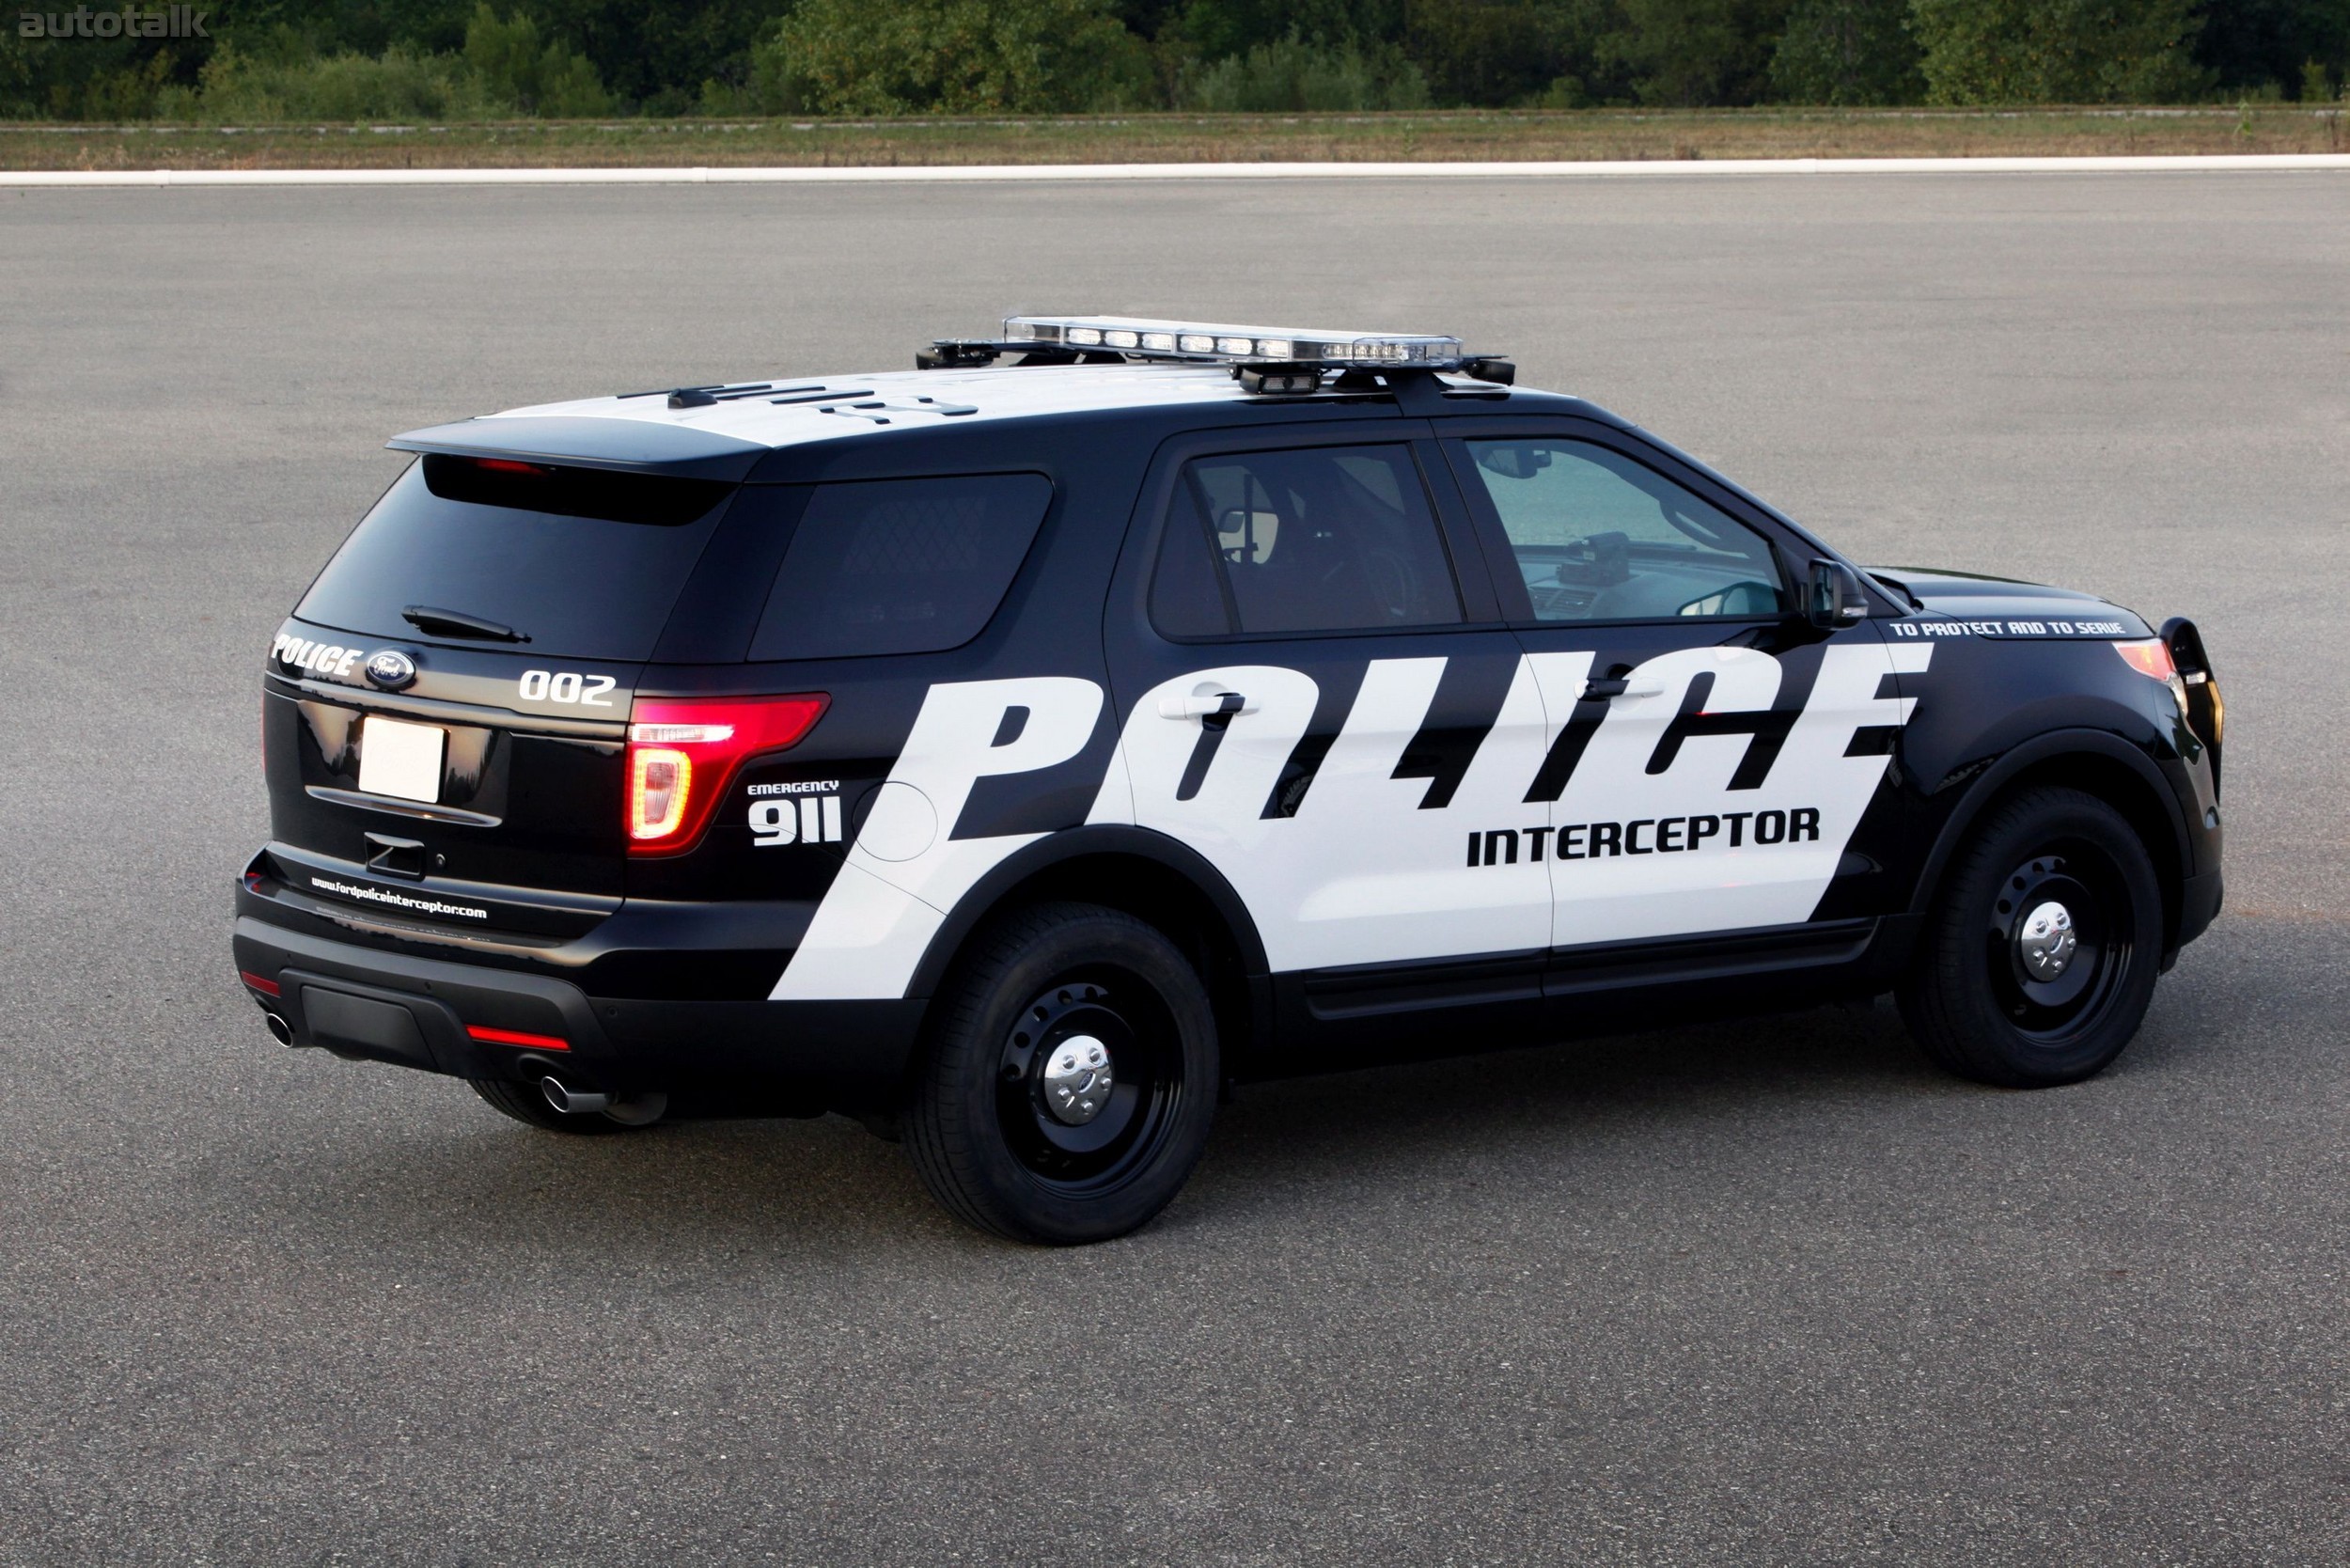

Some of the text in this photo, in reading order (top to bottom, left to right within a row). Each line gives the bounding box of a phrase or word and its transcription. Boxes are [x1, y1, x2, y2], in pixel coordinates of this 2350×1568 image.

[1889, 620, 2126, 636] TO PROTECT AND TO SERVE
[271, 633, 365, 677] POLICE
[373, 656, 402, 678] Ford
[519, 669, 617, 707] 002
[832, 642, 1935, 879] POLICE
[747, 779, 839, 795] EMERGENCY
[748, 795, 842, 847] 911
[1466, 807, 1821, 868] INTERCEPTOR
[311, 876, 488, 919] www.fordpoliceinterceptor.com
